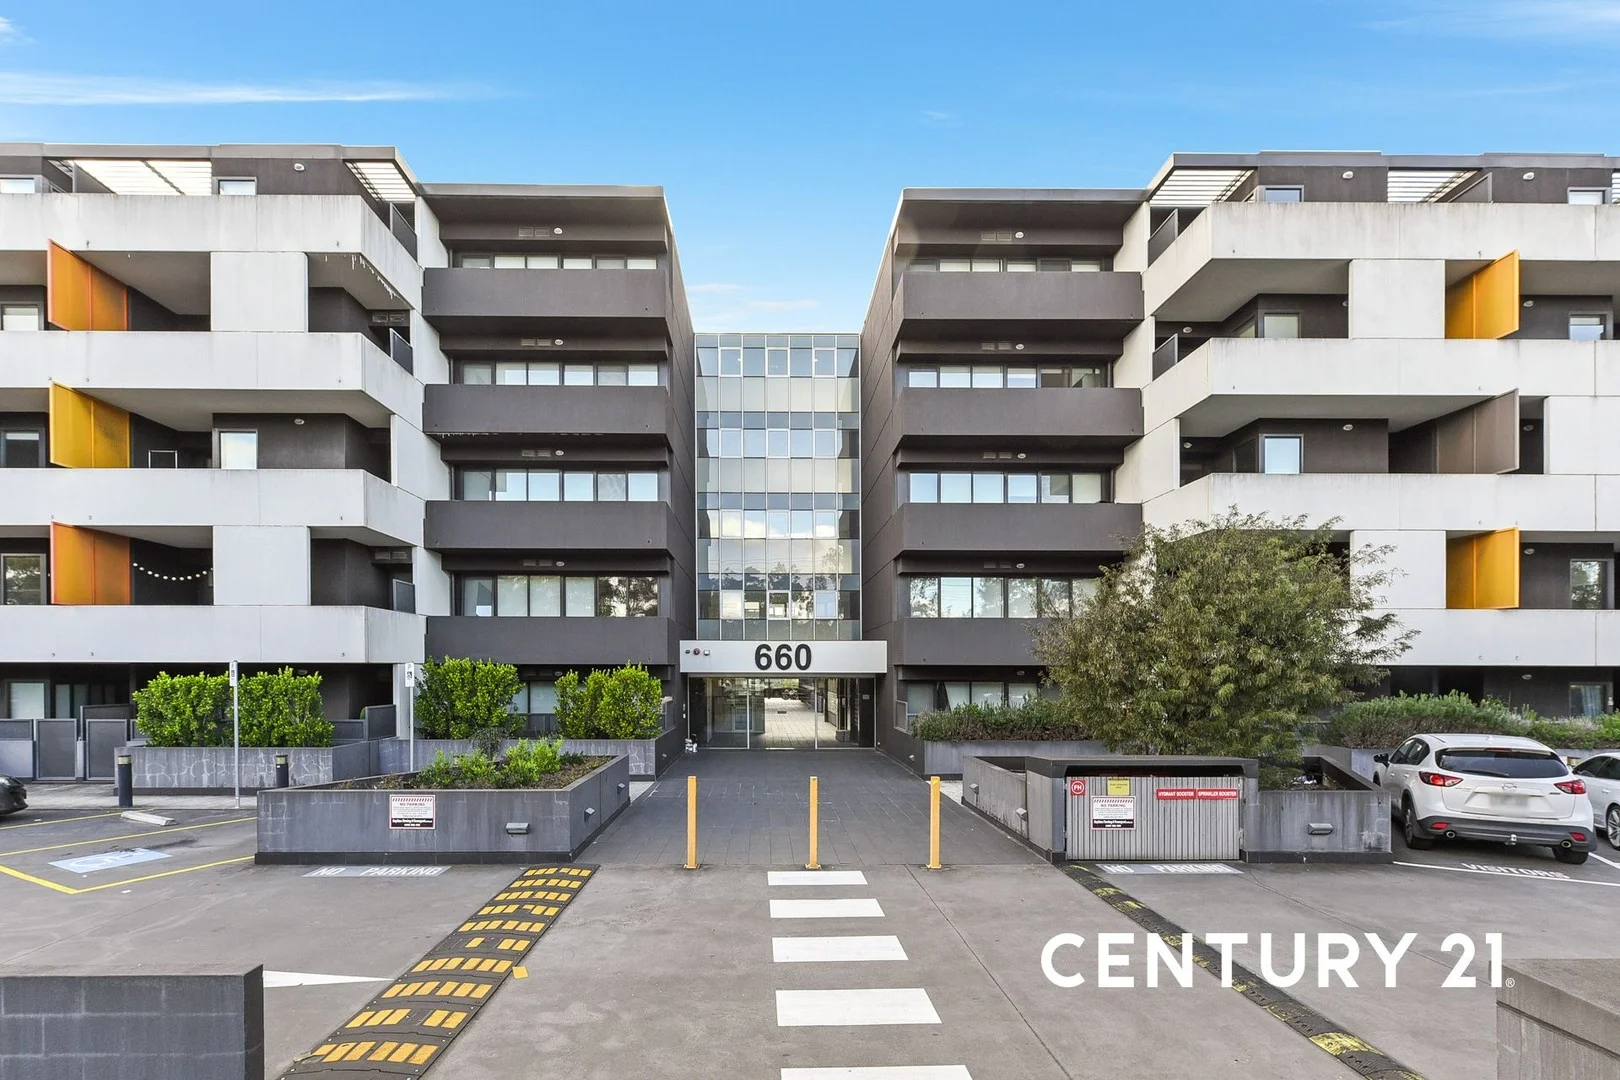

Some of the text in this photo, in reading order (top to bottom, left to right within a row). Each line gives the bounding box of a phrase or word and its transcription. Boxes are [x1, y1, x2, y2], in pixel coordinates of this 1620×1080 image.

[754, 643, 812, 671] 660
[312, 867, 444, 876] NO PARKING
[1103, 864, 1232, 873] NO PARKING
[1461, 862, 1570, 880] VISITORS
